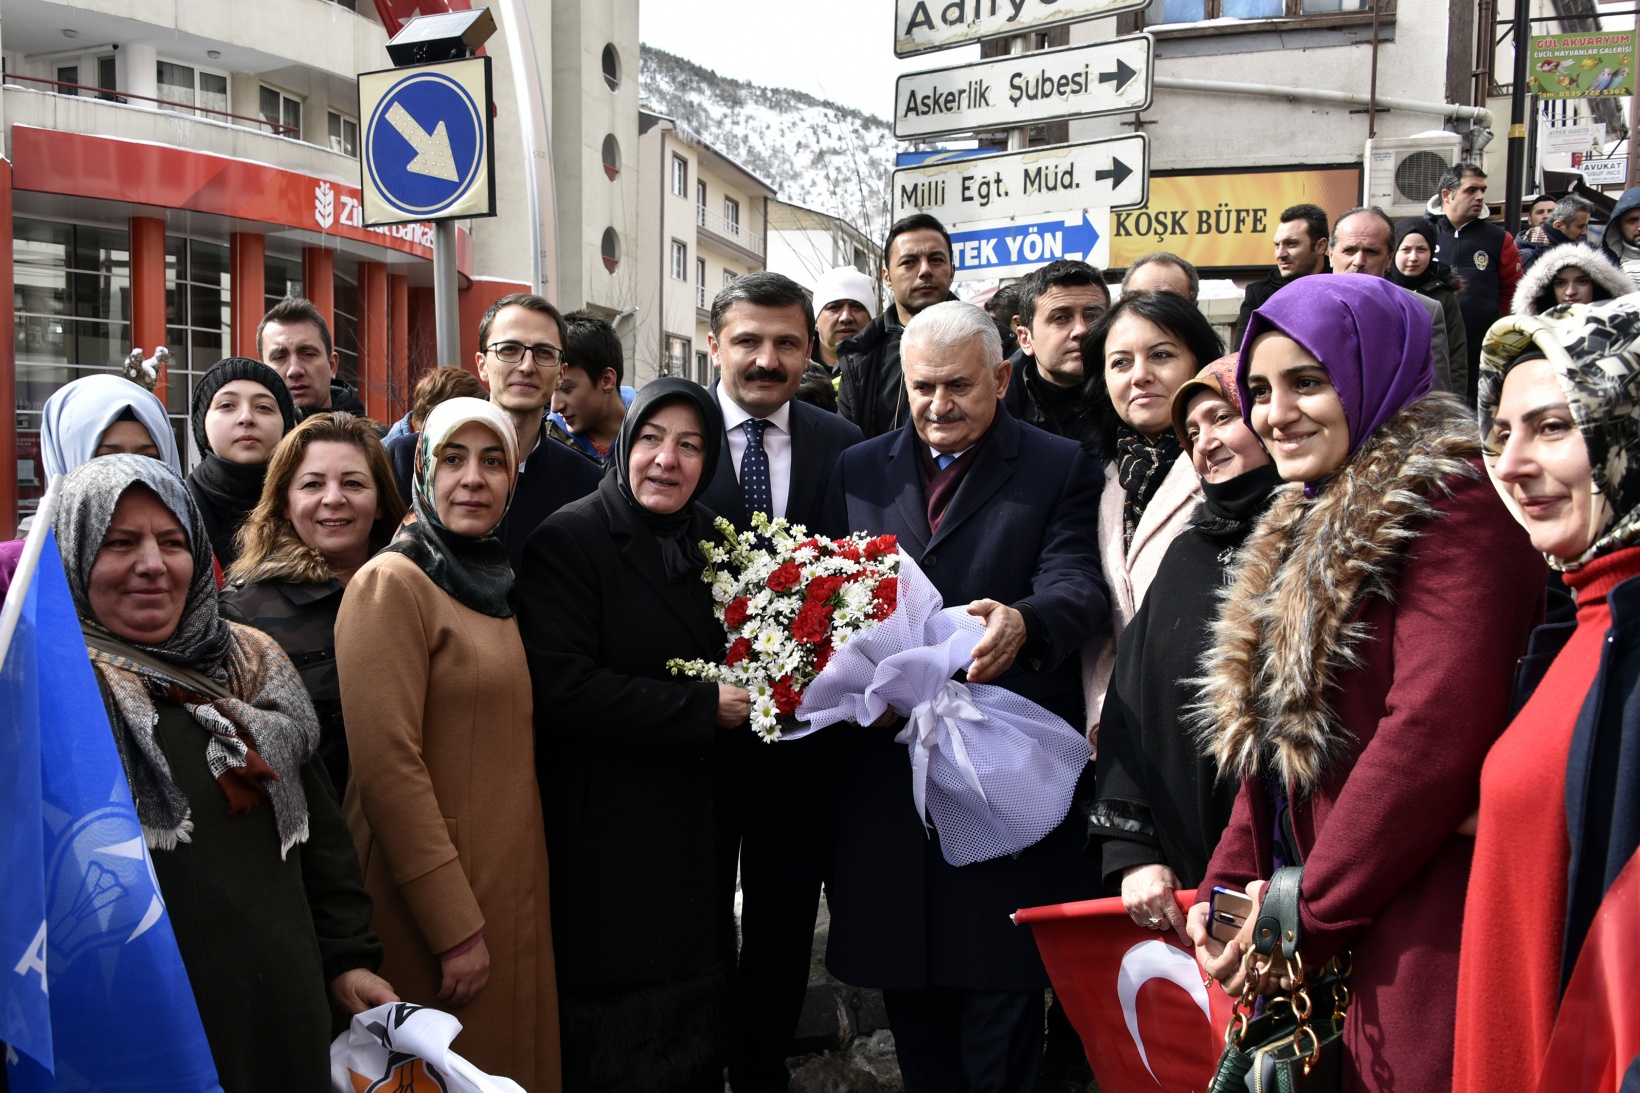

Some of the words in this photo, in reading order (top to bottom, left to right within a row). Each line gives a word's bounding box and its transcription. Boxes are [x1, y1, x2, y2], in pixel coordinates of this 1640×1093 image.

[1534, 50, 1553, 58] EVCİL
[1554, 48, 1598, 56] HAYVANLAR
[1599, 45, 1632, 54] GALERİSİ
[1536, 37, 1559, 49] GÜL
[1562, 33, 1631, 47] AKVARYUM
[904, 78, 990, 118] Askerlik
[1009, 63, 1089, 107] Şubesi
[1584, 162, 1622, 171] AVUKAT
[901, 180, 946, 209] Milli
[961, 172, 1009, 207] Eğt.
[1023, 162, 1080, 195] Müd.
[1196, 203, 1268, 235] BÜFE
[392, 222, 434, 249] Bankas
[952, 237, 999, 268] TEK
[1005, 227, 1063, 262] YÖN
